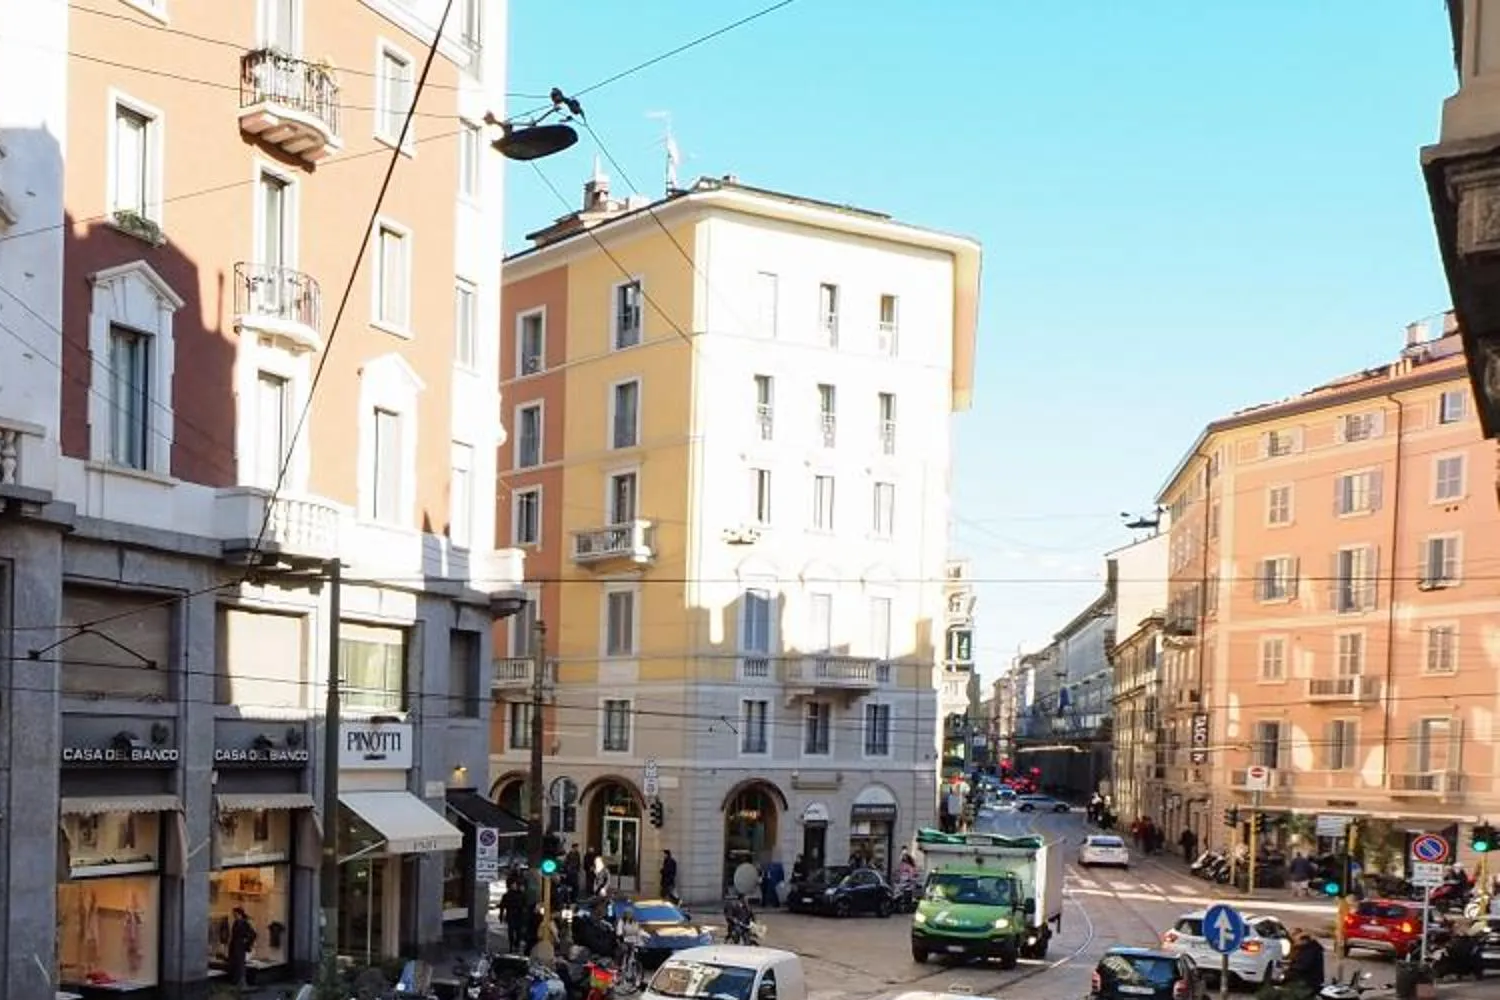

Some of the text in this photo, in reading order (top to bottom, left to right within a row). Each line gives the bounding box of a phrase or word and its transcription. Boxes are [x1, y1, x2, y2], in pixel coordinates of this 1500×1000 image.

[347, 731, 401, 752] PINOTTI
[63, 748, 103, 761] CASA
[131, 748, 179, 761] BIANCO
[214, 749, 247, 761] CASA
[269, 749, 309, 761] BIANCO
